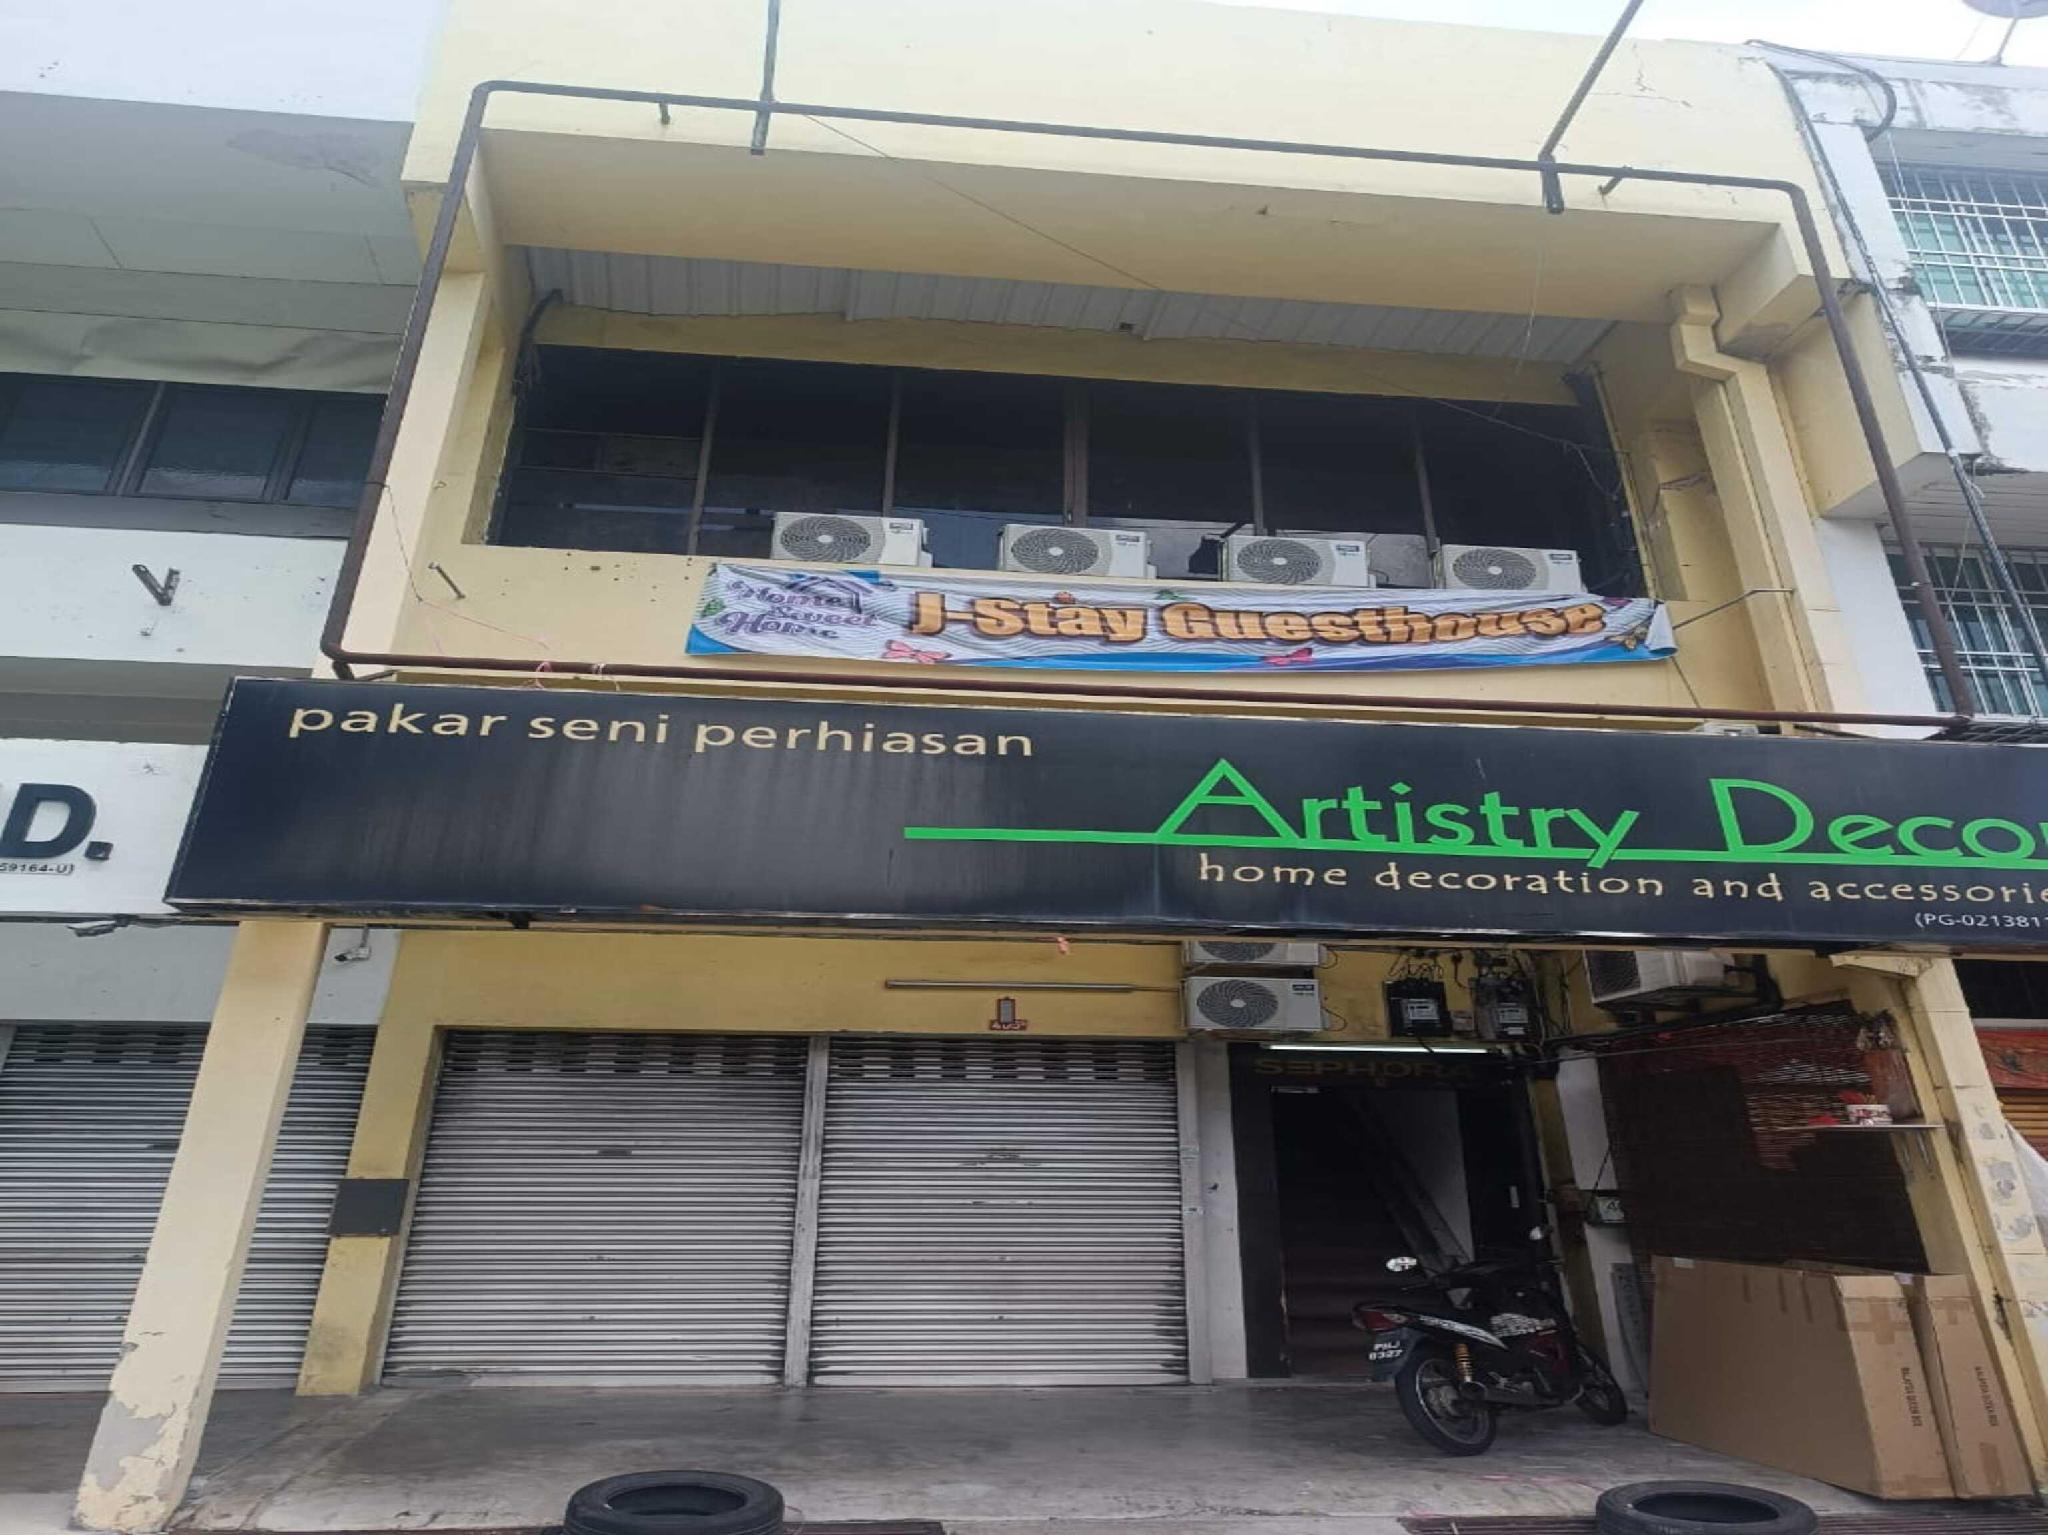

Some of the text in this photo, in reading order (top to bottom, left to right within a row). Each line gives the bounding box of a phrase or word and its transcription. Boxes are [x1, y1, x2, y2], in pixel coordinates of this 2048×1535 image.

[908, 590, 1607, 645] J-Stay Guesthouse
[288, 703, 1034, 757] pakar seni perhiasan
[1155, 757, 1640, 869] Artistry
[1199, 853, 1348, 886] home
[1375, 861, 1664, 895] decoration
[1692, 873, 1784, 901] and
